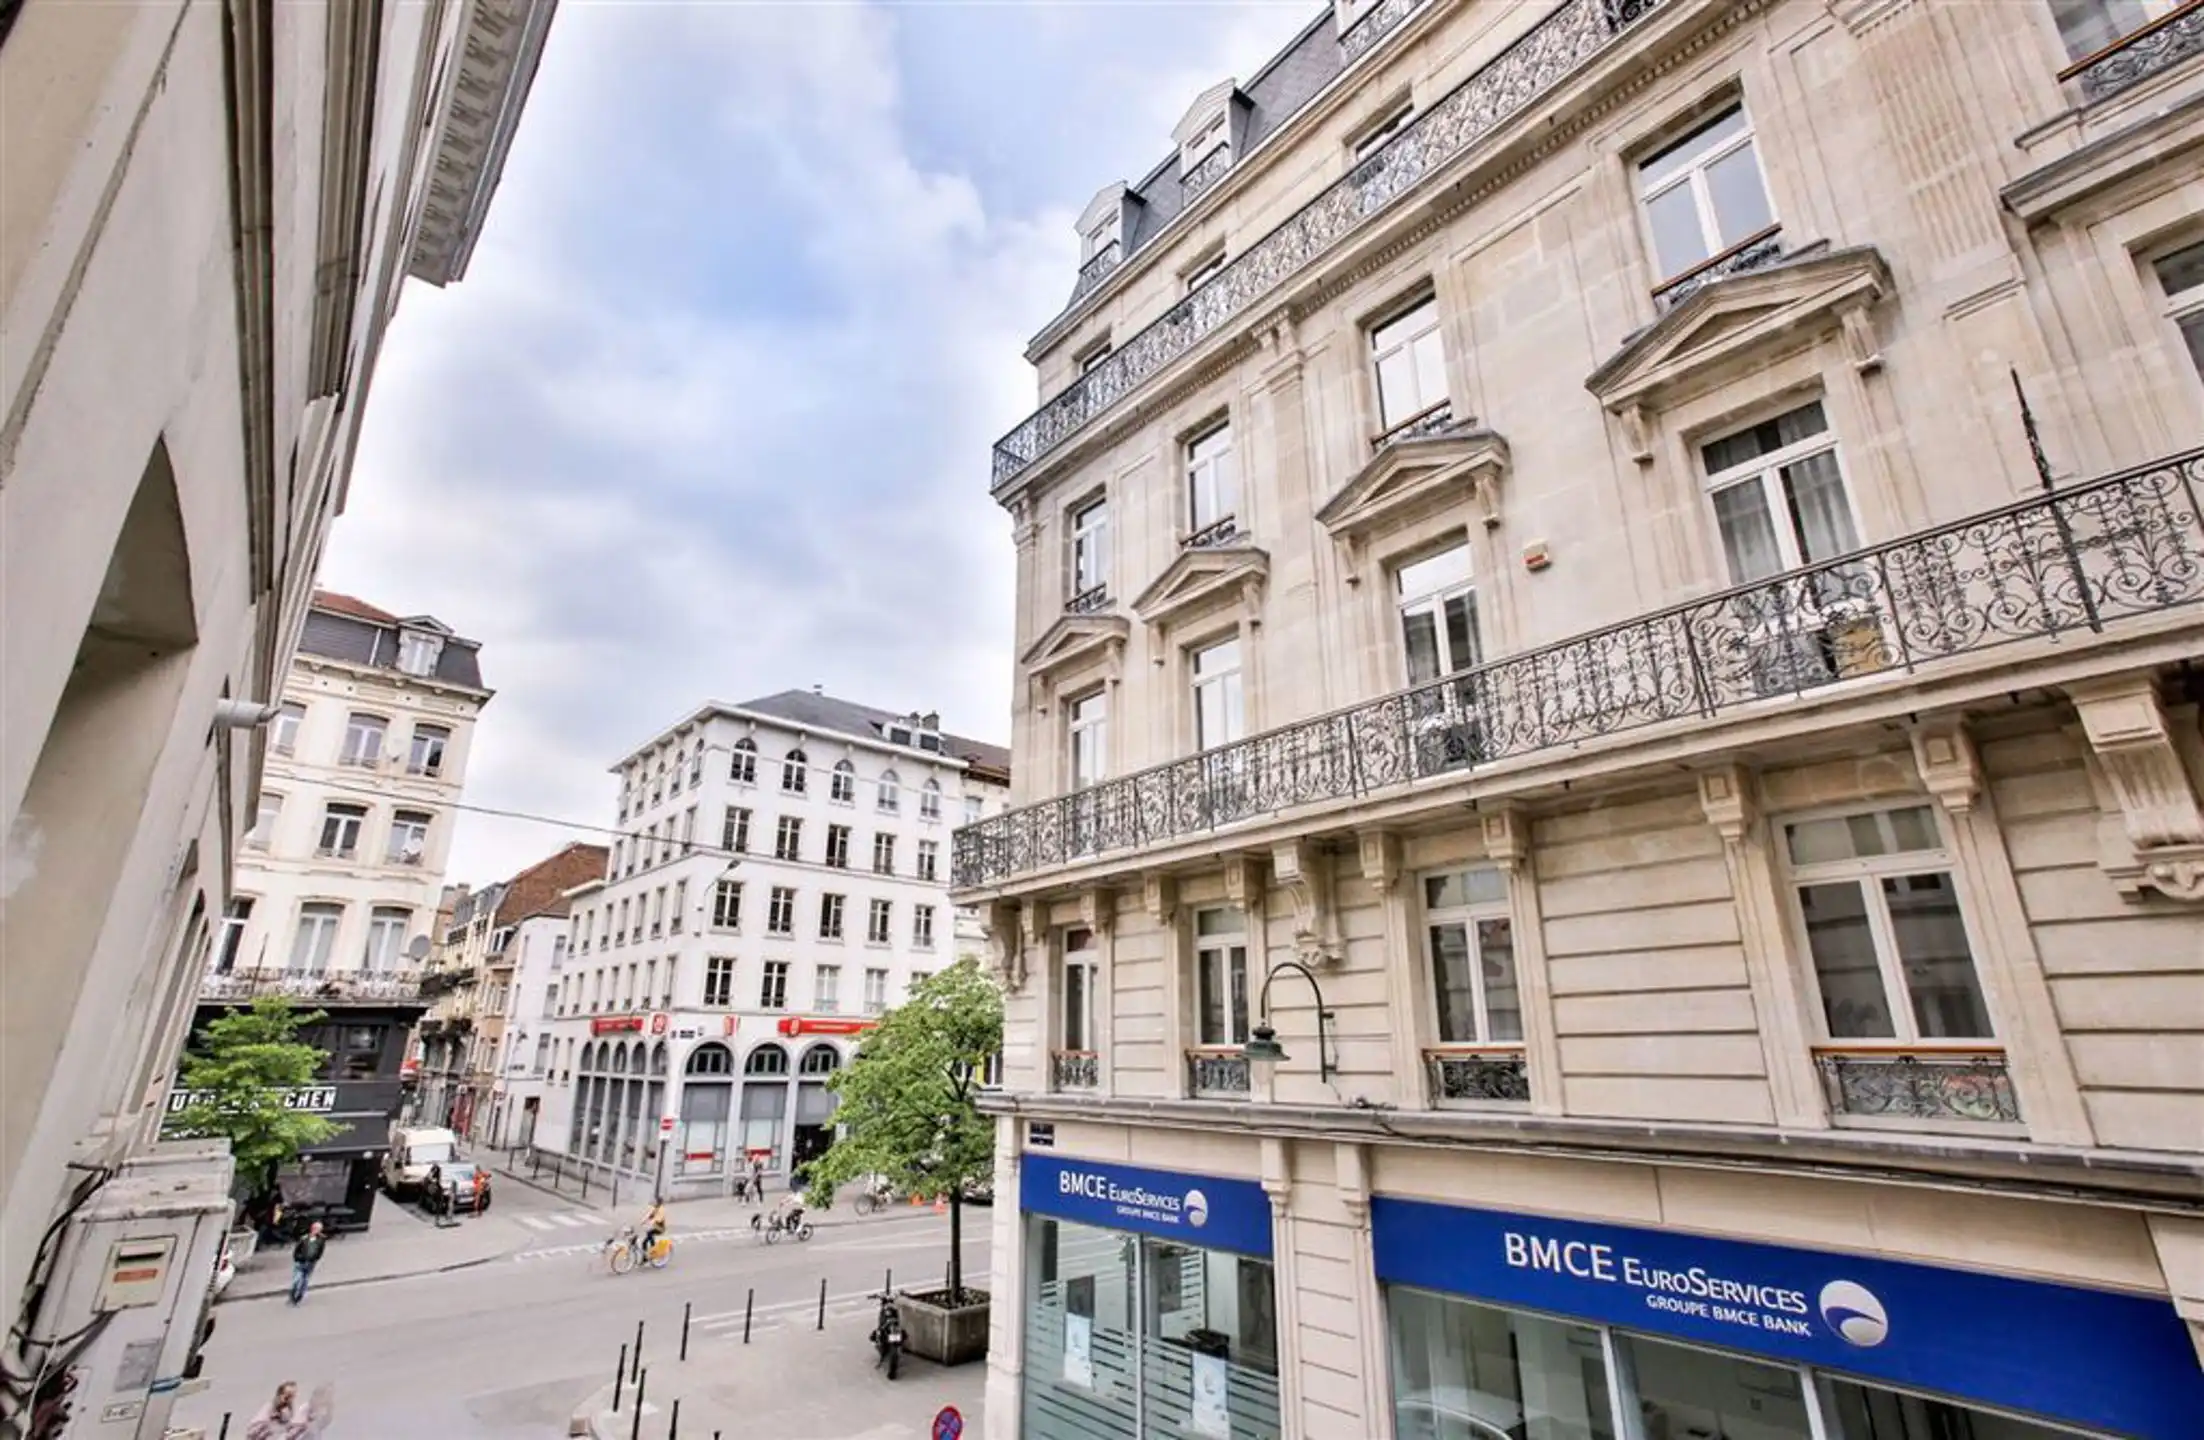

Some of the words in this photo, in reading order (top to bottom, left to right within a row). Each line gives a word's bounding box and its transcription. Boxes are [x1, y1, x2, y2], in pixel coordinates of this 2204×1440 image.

[1060, 1170, 1107, 1200] BMCE
[1504, 1232, 1617, 1282] BMCE
[1646, 1294, 1709, 1318] GROUPE
[1712, 1306, 1758, 1327] BMCE
[1763, 1315, 1812, 1337] BANK
